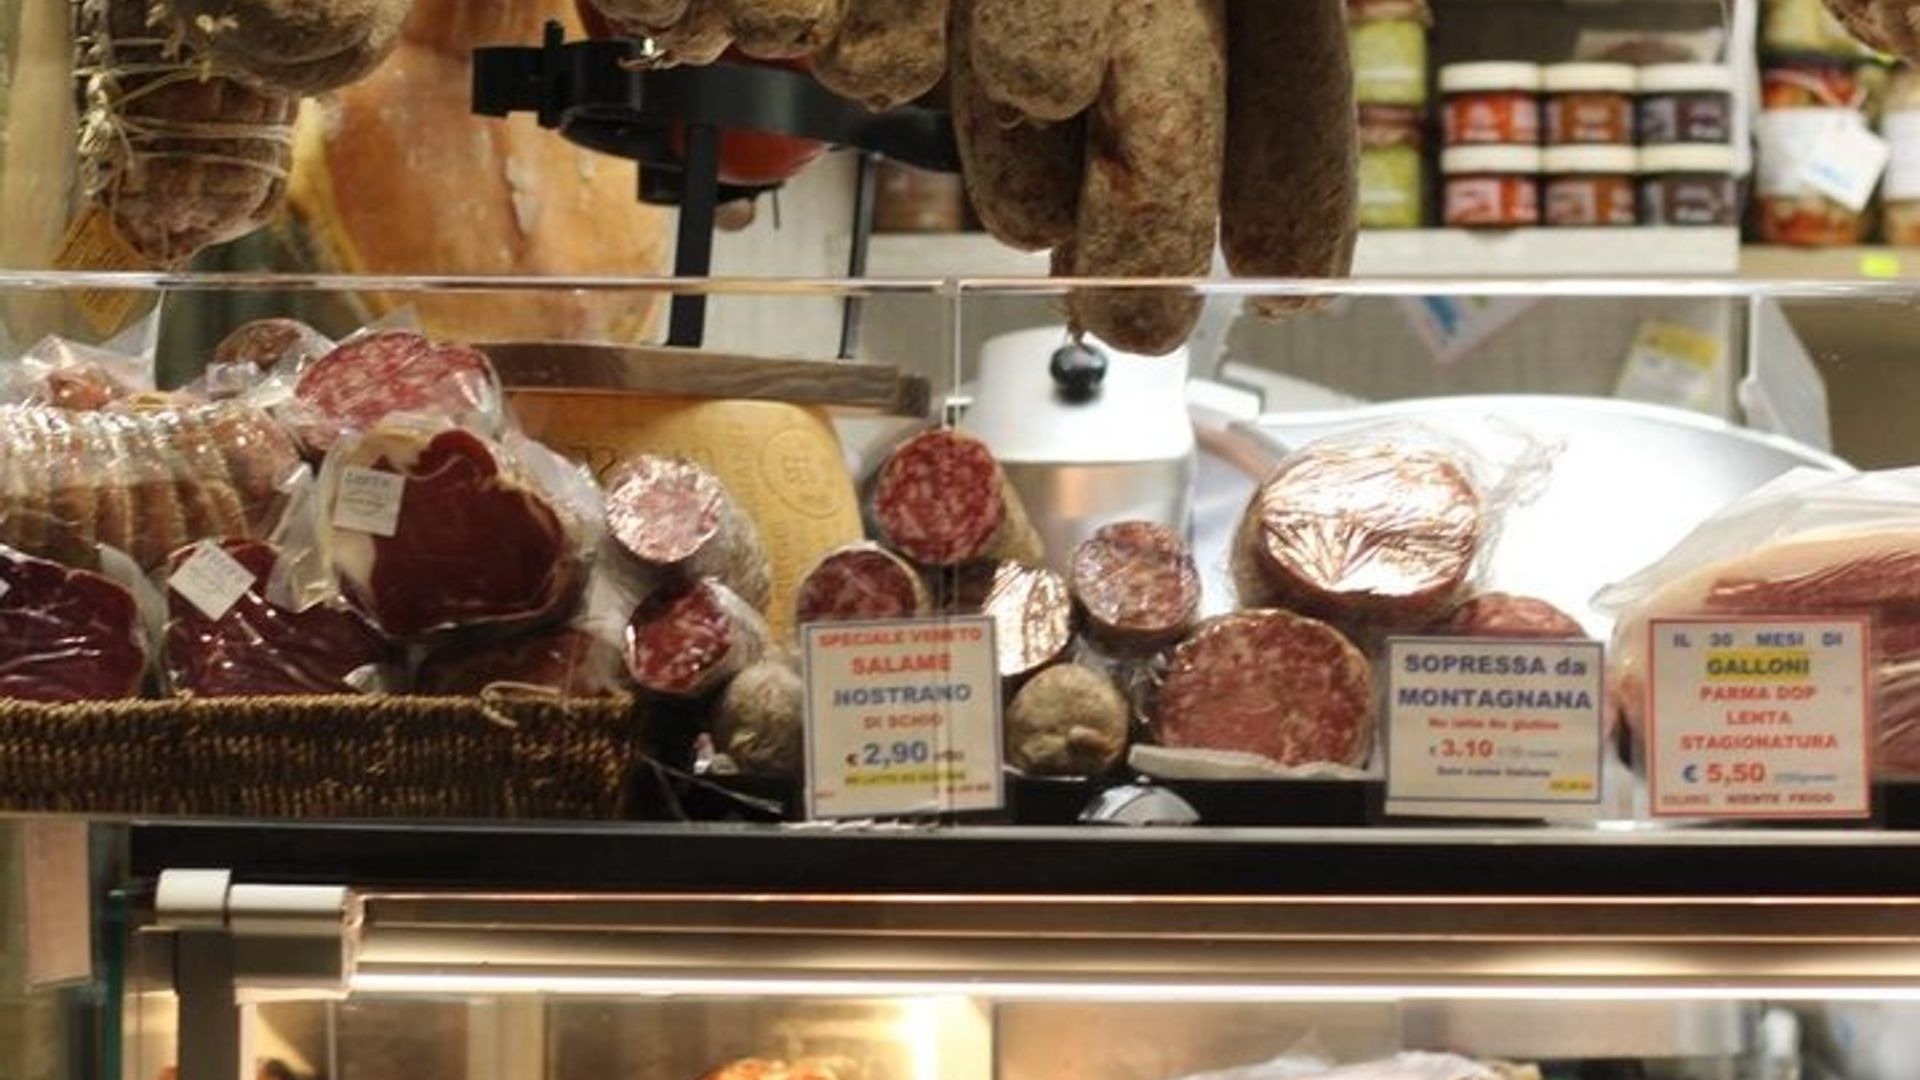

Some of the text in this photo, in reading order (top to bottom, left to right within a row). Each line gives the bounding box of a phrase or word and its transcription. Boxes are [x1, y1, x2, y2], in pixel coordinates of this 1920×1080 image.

[819, 627, 982, 647] SPECIALE VENETO
[1673, 633, 1691, 647] IL
[1755, 632, 1804, 646] MESI
[1822, 632, 1843, 646] DI
[852, 653, 952, 674] SALAME
[1405, 655, 1587, 676] SOPRESSA da
[1707, 658, 1809, 675] GALLONI
[834, 684, 972, 706] NOSTRANO
[1400, 688, 1593, 709] MONTAGNANA
[1701, 685, 1816, 700] PARMA DOP
[863, 712, 943, 730] DI SCHIO
[1726, 711, 1793, 725] LENTA
[1440, 739, 1495, 758] 3.10
[1681, 734, 1838, 750] STAGIONATURA
[845, 752, 858, 768] €
[863, 741, 929, 768] 2,90
[1682, 763, 1699, 784] €
[1705, 763, 1766, 786] 5,50
